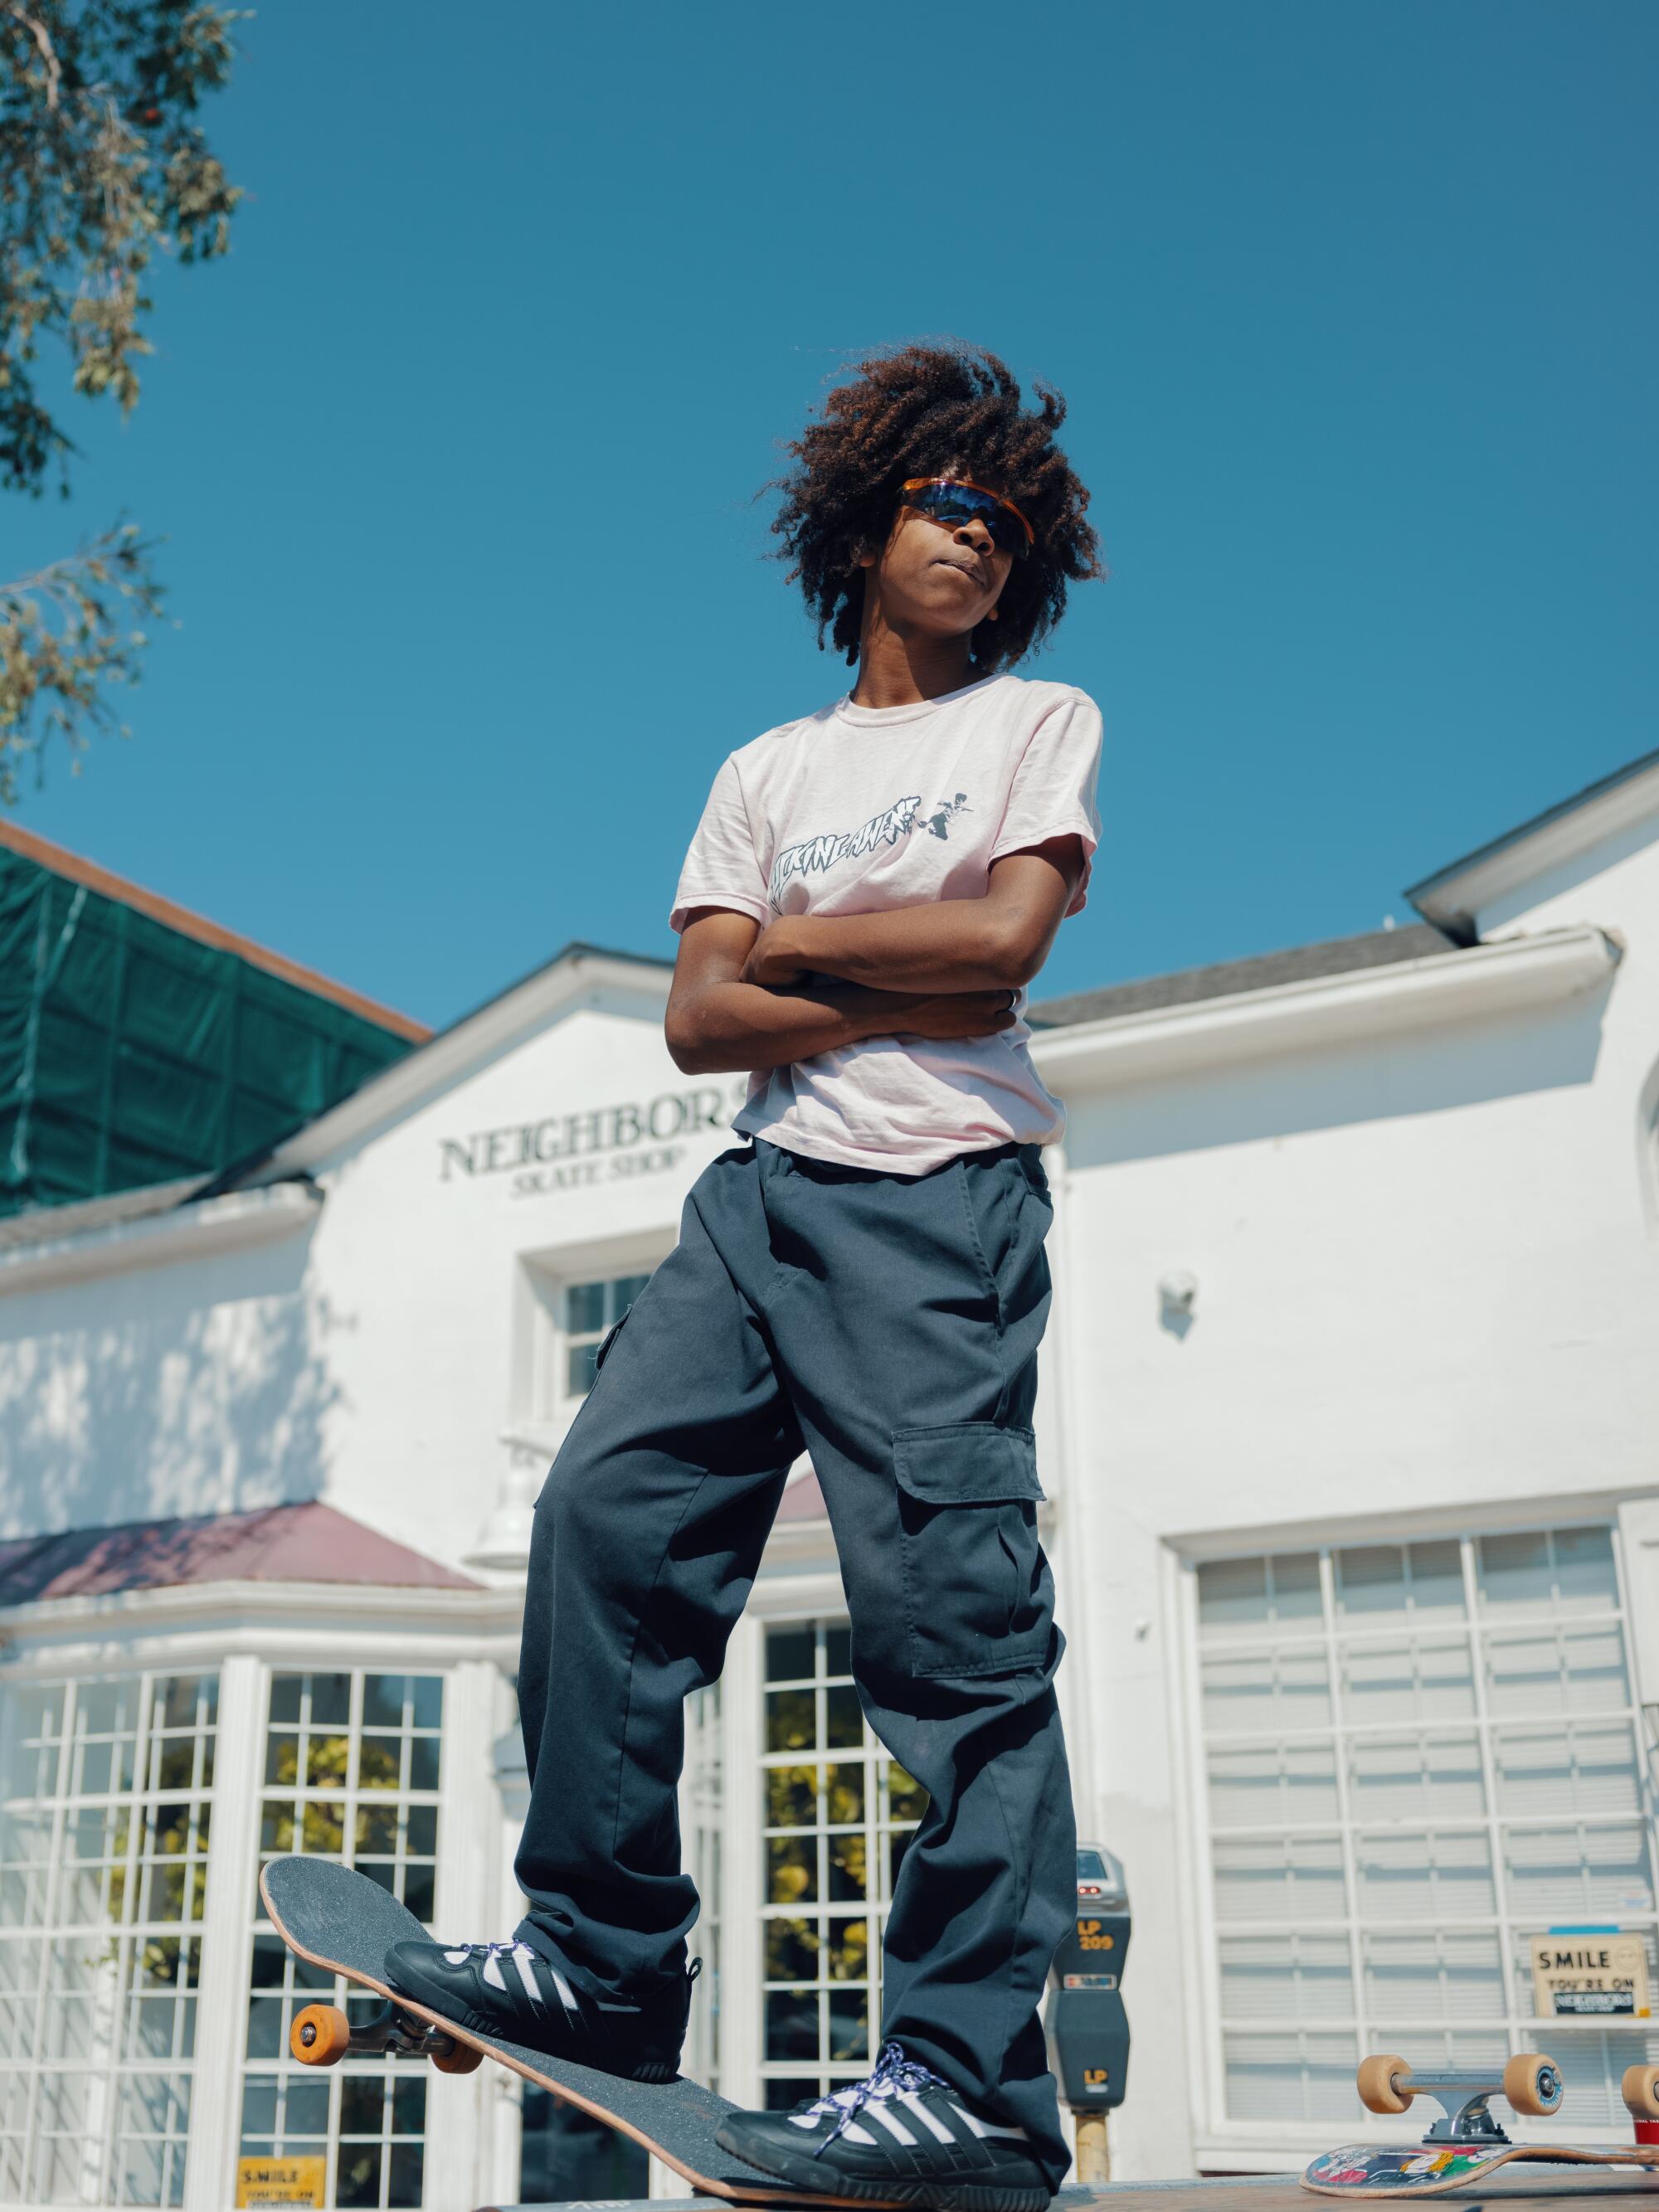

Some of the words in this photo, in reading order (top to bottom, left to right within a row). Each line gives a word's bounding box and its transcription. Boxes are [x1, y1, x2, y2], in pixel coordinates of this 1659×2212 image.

[509, 1164, 601, 1200] SKATE
[606, 1144, 687, 1181] SHOP
[1077, 1920, 1102, 1935] LP
[1539, 1951, 1610, 1969] SMILE
[1613, 1978, 1634, 1991] ON
[1083, 2070, 1107, 2084] LP
